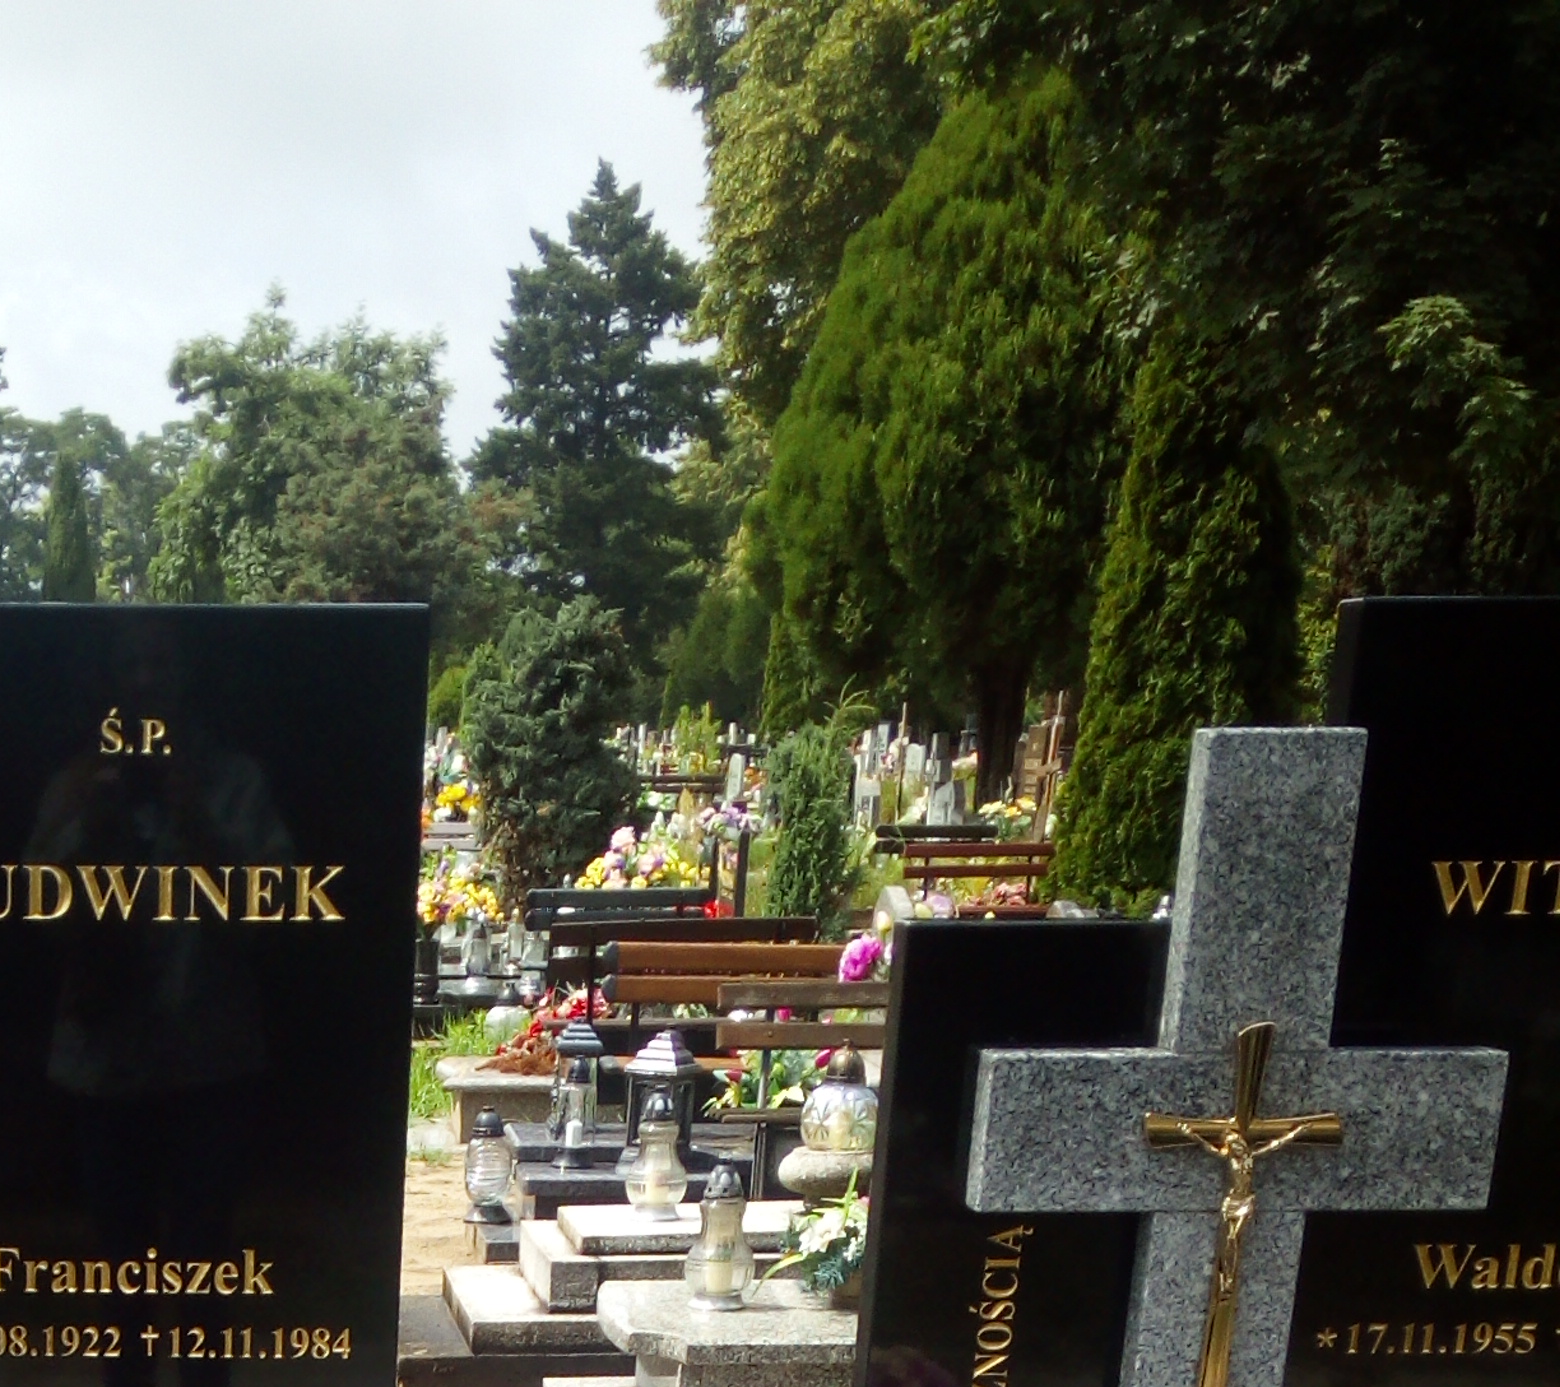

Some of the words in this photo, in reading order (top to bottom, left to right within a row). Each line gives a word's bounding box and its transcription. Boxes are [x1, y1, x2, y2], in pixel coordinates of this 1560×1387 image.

[1415, 1243, 1560, 1290] Wald
[169, 1327, 352, 1360] 12.11.1984
[1347, 1323, 1537, 1354] 17.11.1955
